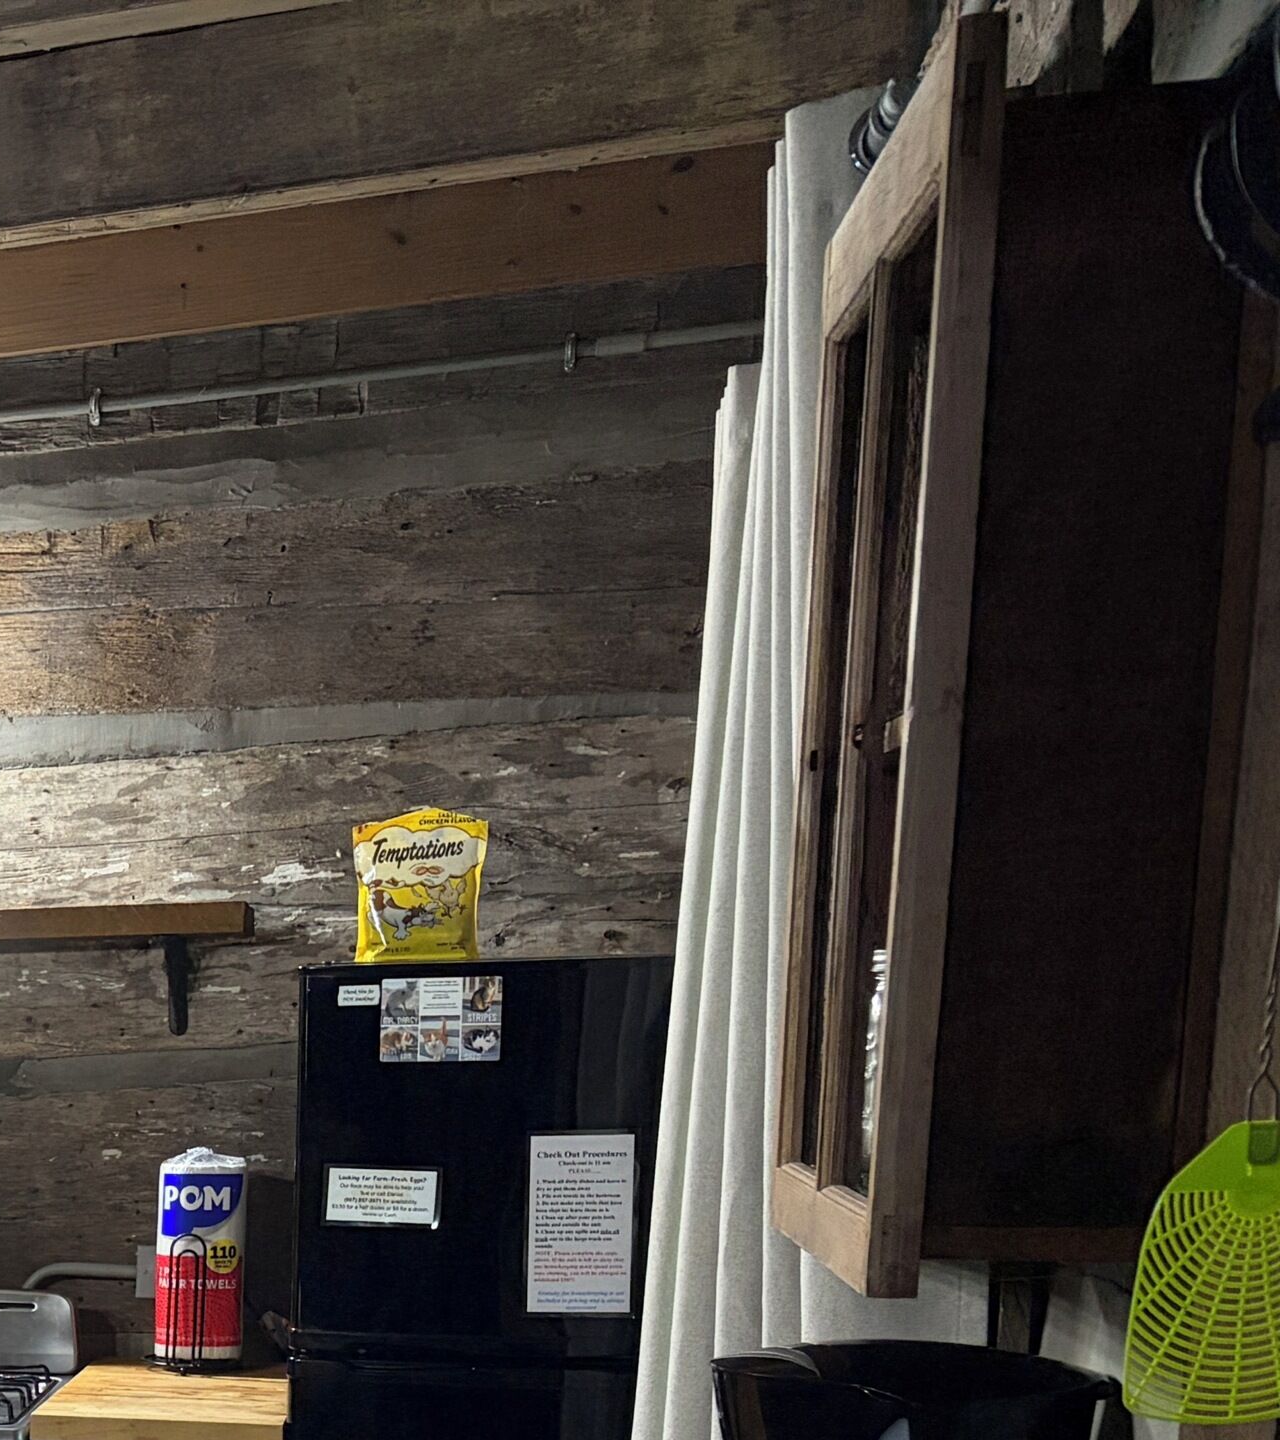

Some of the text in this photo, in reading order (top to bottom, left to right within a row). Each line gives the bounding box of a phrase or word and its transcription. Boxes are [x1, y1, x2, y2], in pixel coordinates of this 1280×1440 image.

[372, 838, 464, 868] Temptations
[468, 1014, 497, 1022] STRIPES
[164, 1186, 231, 1211] POM
[210, 1246, 236, 1258] 110
[189, 1279, 236, 1290] TOWELS
